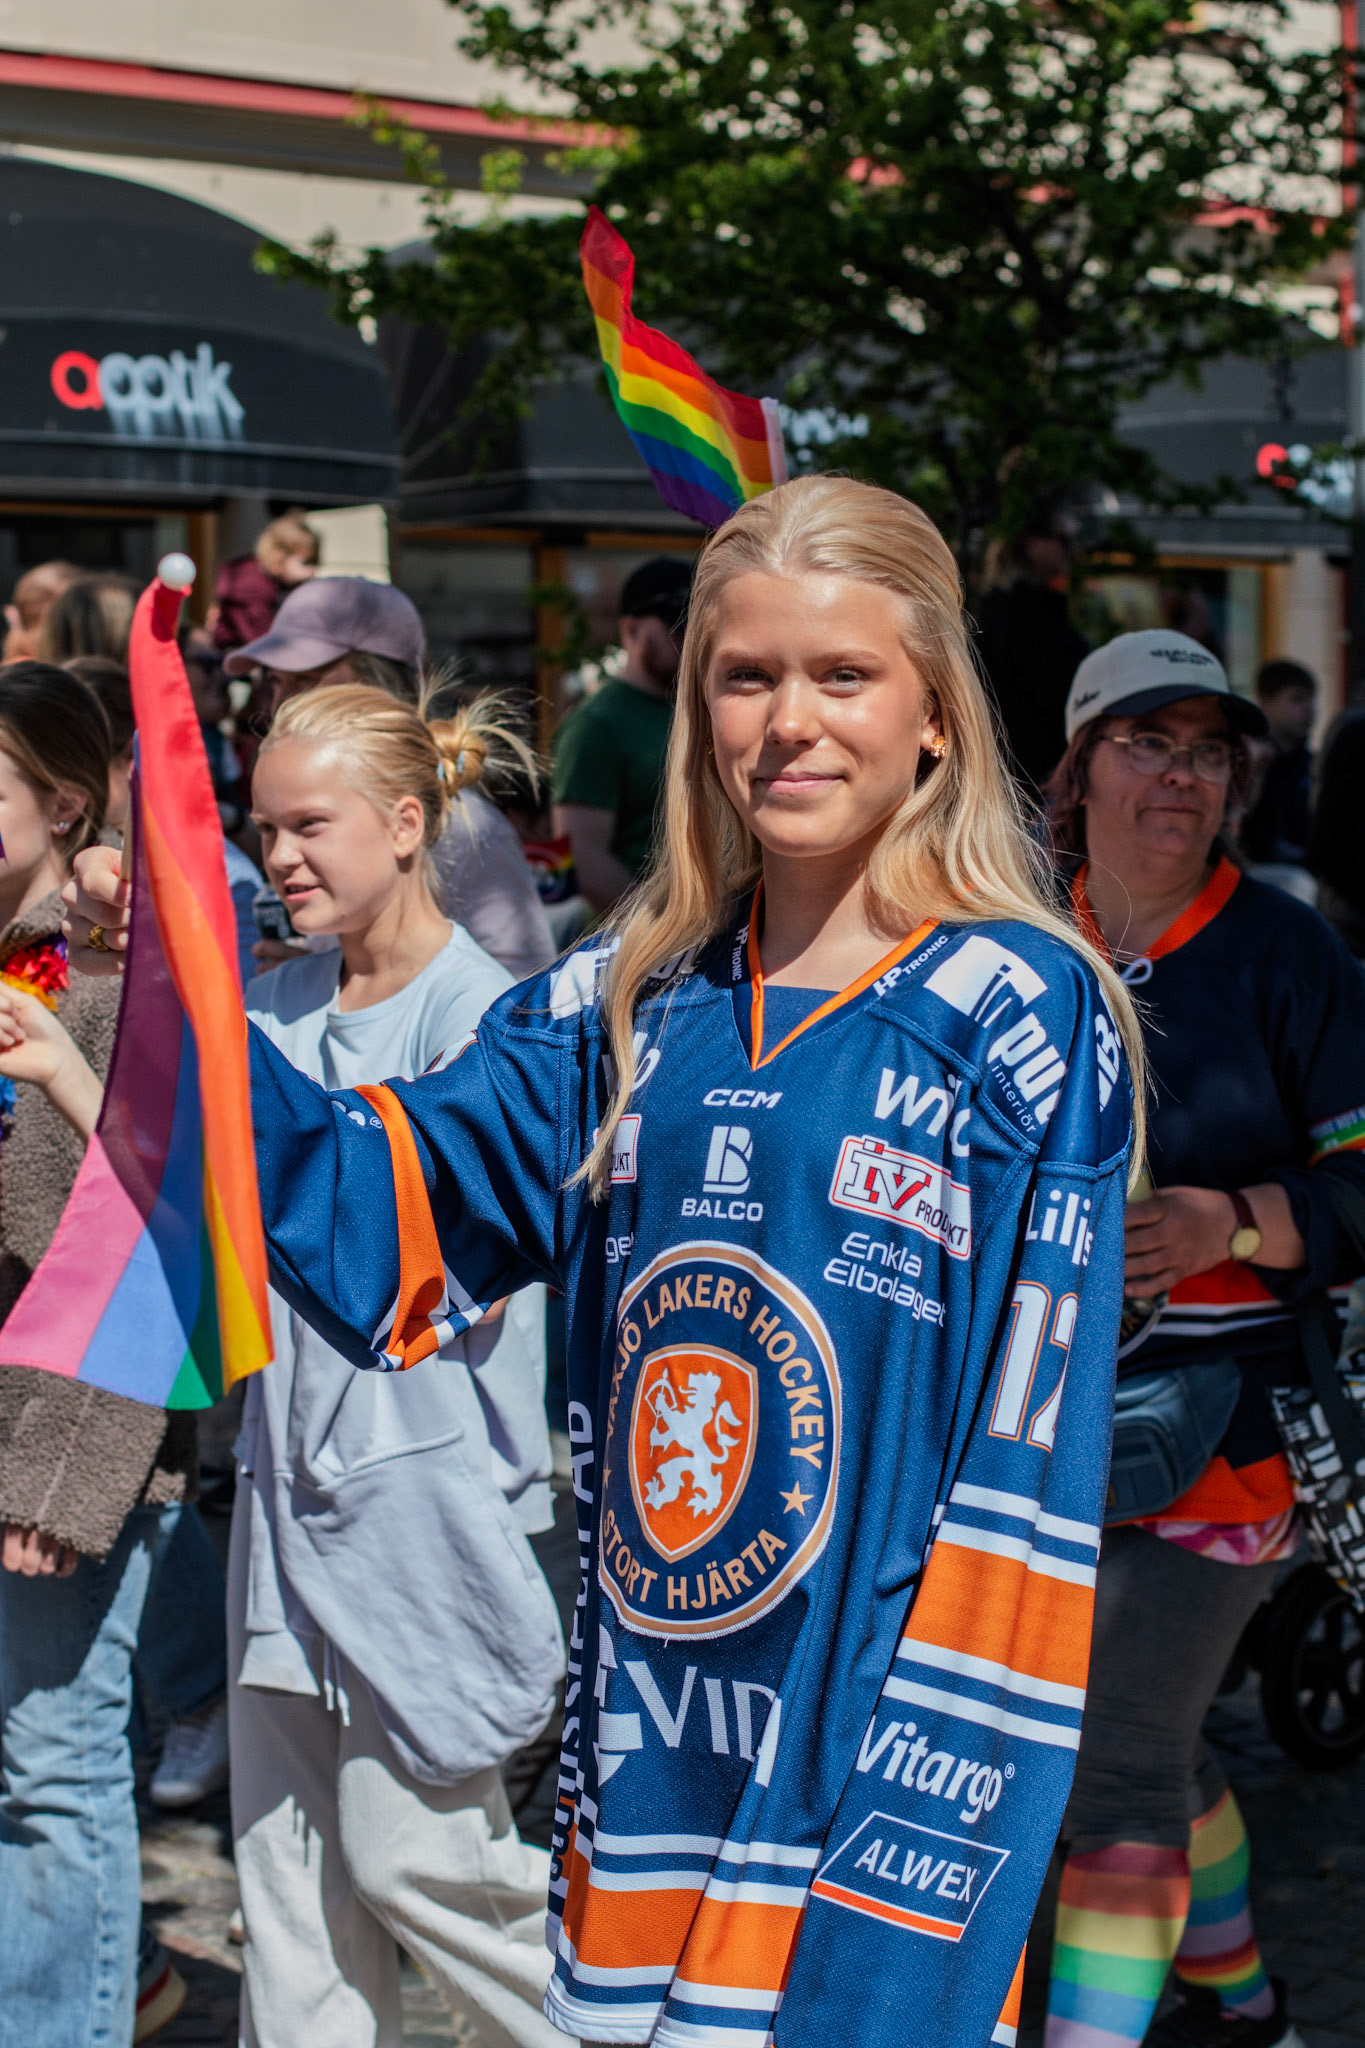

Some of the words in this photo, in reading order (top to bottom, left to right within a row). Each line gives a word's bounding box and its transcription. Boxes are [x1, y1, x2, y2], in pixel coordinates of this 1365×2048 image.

[732, 945, 742, 981] TRONIC
[873, 967, 902, 997] HP
[902, 936, 949, 975] TRONIC
[703, 1088, 783, 1109] CCM
[991, 1063, 1037, 1133] interiör
[681, 1198, 763, 1221] BALCO
[915, 1199, 968, 1246] PRODKT
[841, 1231, 922, 1278] Enkla
[823, 1257, 946, 1328] Elbolaget
[643, 1274, 752, 1330] LAKERS
[749, 1304, 825, 1471] HOCKEY
[604, 1508, 658, 1603] STORT
[666, 1528, 788, 1612] HJÄRTA
[855, 1714, 1003, 1824] Vitargo
[854, 1838, 978, 1903] ALWEX
